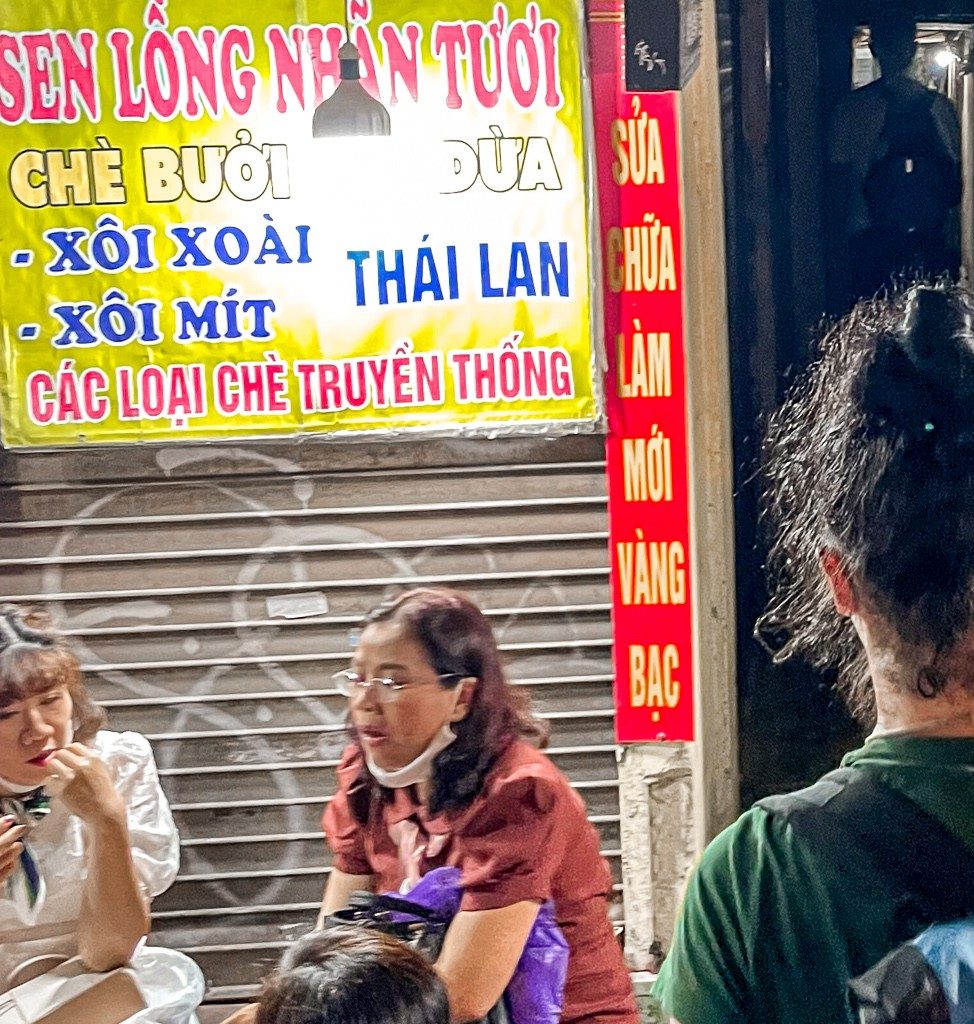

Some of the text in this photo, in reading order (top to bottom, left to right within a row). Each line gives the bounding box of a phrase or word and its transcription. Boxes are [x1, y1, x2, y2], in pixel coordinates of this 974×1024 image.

[0, 32, 97, 121] SEN
[435, 6, 560, 109] TƯƠI
[9, 136, 127, 208] CHÈ
[142, 129, 291, 202] BƯỞI
[611, 95, 665, 186] SỬA
[47, 217, 154, 272] XÔI
[171, 213, 313, 267] XOÀI
[347, 231, 570, 307] THÁI LAN
[607, 213, 677, 292] CHỮA
[54, 290, 160, 345] XÔI
[176, 288, 276, 340] MÍT
[30, 334, 573, 426] CÁC LOẠI CHÈ TRUYỀN THỐNG
[616, 319, 671, 398] LÀM
[622, 424, 673, 502] MỚI
[617, 528, 686, 605] VÀNG
[629, 644, 680, 722] BẠC
